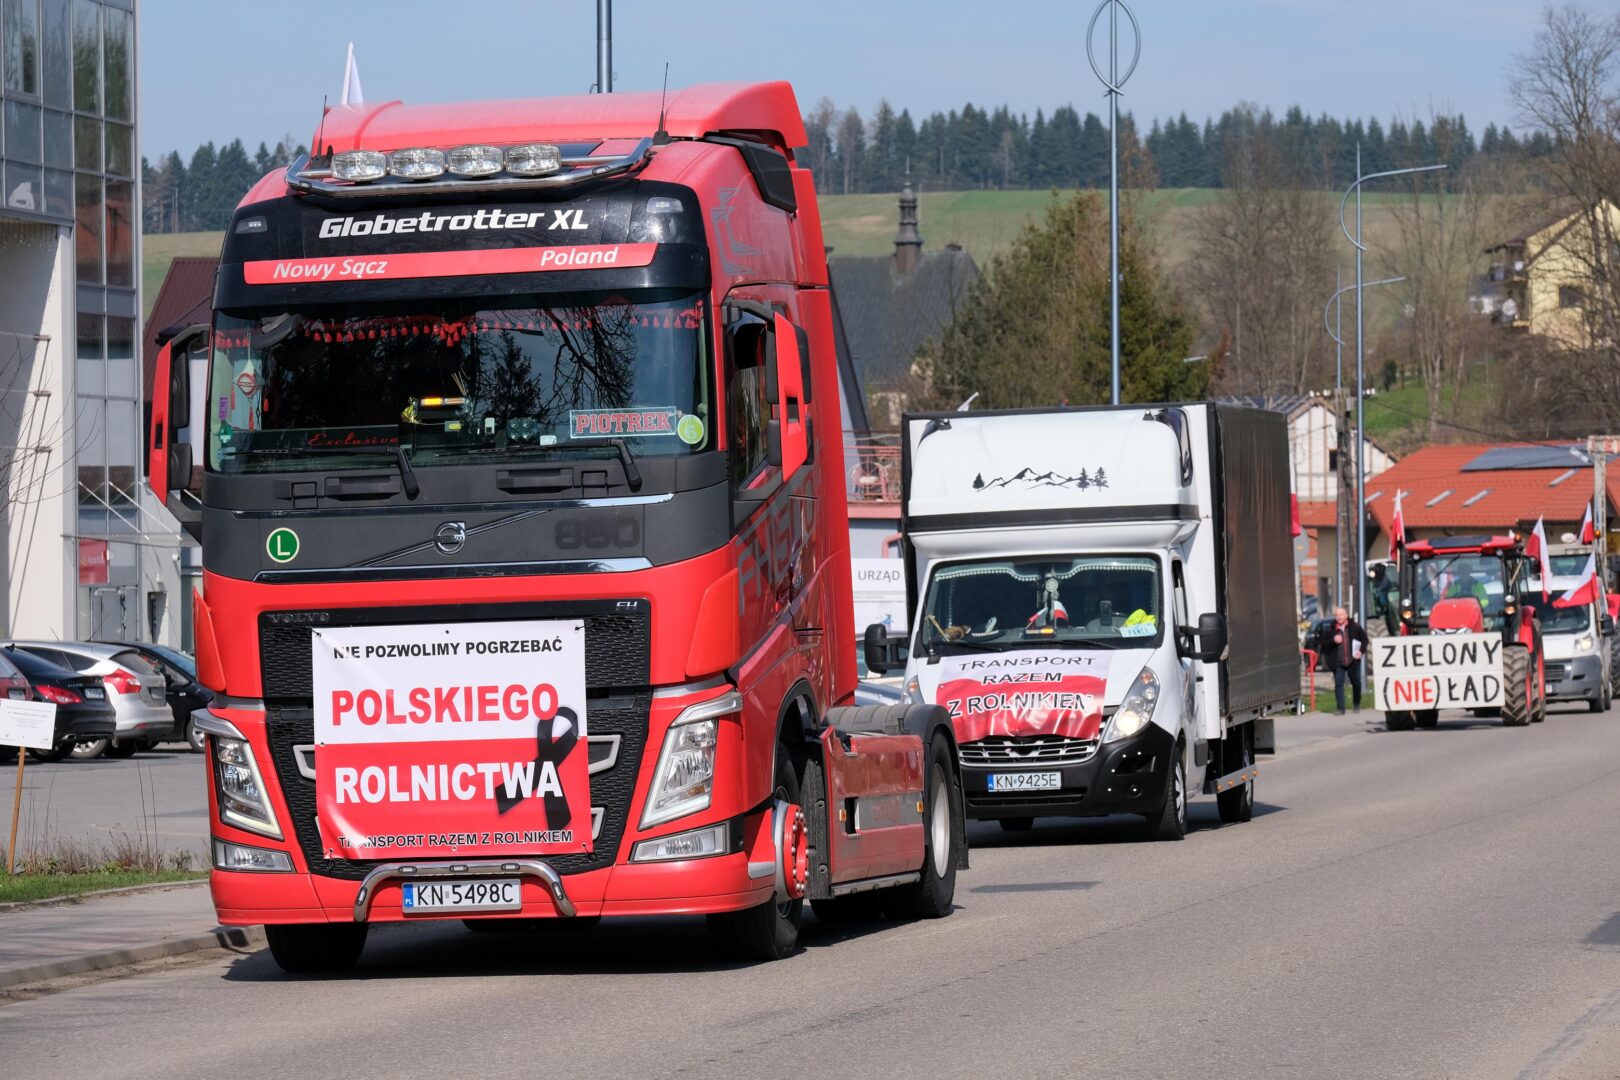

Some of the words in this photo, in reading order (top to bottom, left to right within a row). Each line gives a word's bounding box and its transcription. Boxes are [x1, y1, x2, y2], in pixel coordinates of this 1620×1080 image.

[319, 209, 546, 239] Globetrotter
[548, 209, 589, 230] XL
[540, 247, 620, 267] Poland
[273, 262, 336, 280] Nowy
[339, 258, 388, 278] Sącz
[576, 411, 673, 434] PIOTREK
[307, 431, 400, 447] Exclusive
[276, 535, 291, 556] L
[858, 570, 901, 583] URZĄD
[333, 646, 360, 659] NIE
[365, 642, 461, 658] POZWOLIMY
[465, 636, 563, 655] POGRZEBAĆ
[1381, 640, 1502, 668] ZIELONY
[959, 656, 1096, 671] TRANSPORT
[983, 672, 1062, 685] RAZEM
[1383, 675, 1440, 711] (NIE)
[1447, 675, 1500, 703] ŁAD
[331, 682, 559, 726] POLSKIEGO
[948, 700, 962, 717] Z
[334, 761, 564, 804] ROLNICTWA
[996, 775, 1013, 788] KN
[1017, 773, 1057, 788] 9425E
[338, 834, 424, 849] TNSPORT
[428, 833, 478, 846] RAZEM
[480, 832, 491, 845] Z
[494, 830, 573, 845] ROLNIKIEM
[417, 885, 444, 906] KN
[452, 883, 514, 905] 5498C
